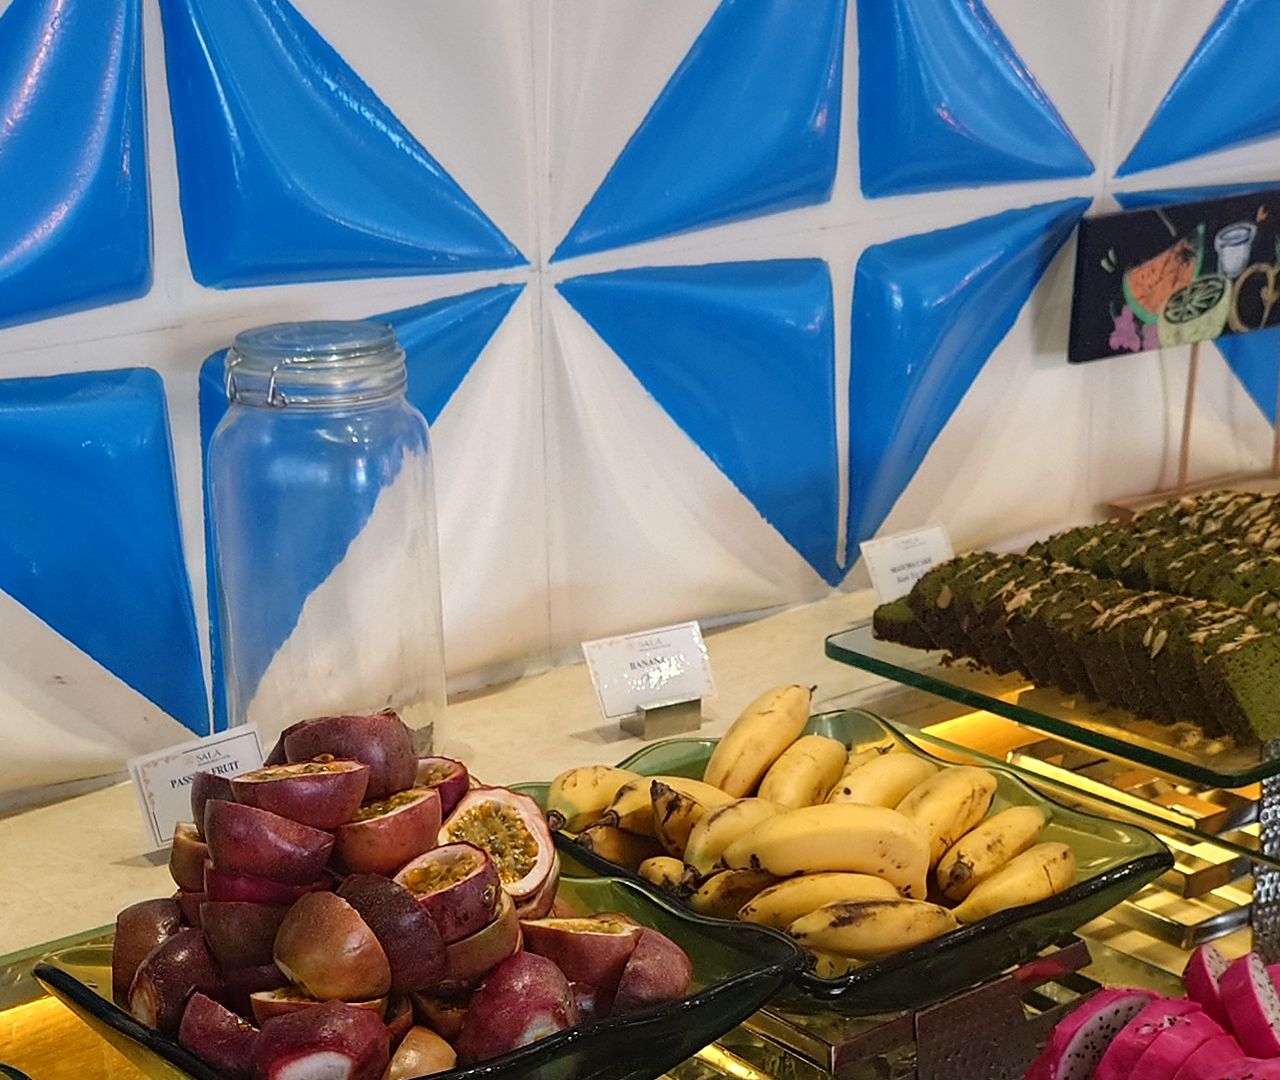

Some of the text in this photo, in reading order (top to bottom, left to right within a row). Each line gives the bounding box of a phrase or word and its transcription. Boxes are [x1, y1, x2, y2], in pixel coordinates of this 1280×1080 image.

[196, 749, 221, 761] SALA
[170, 772, 196, 789] PASS
[211, 760, 239, 775] FRUIT
